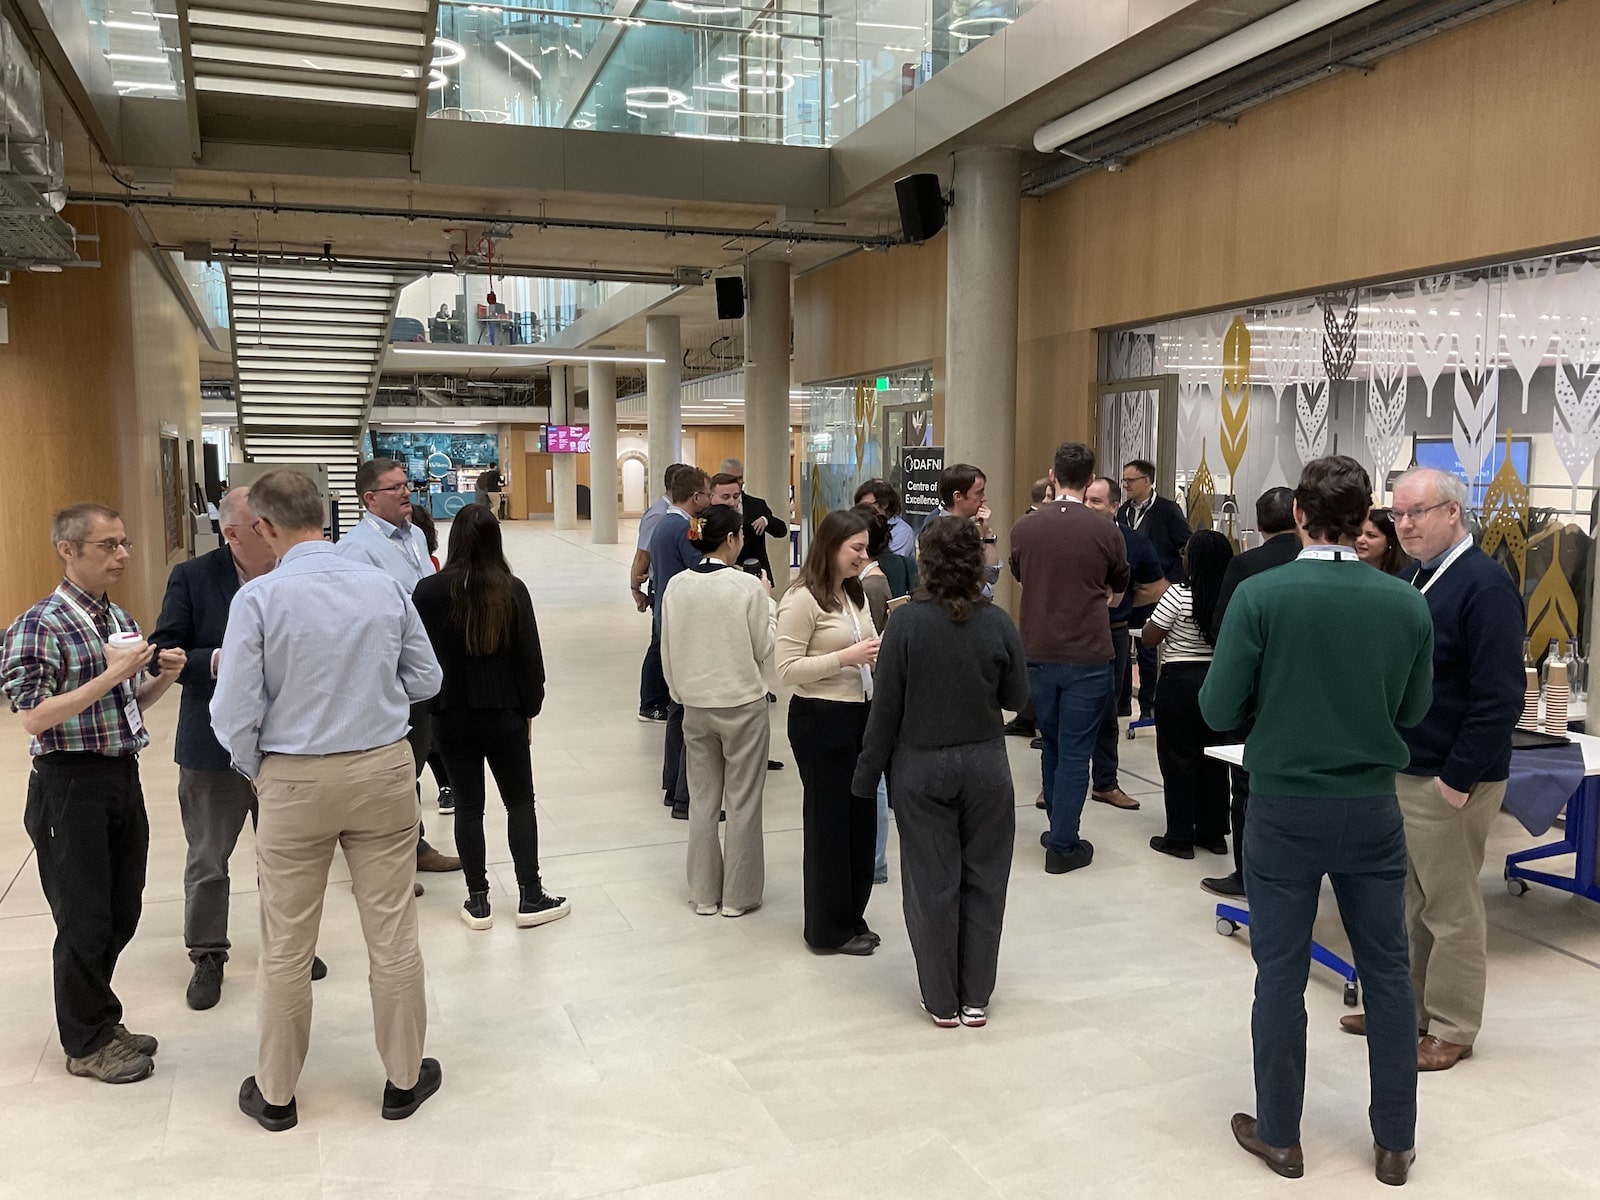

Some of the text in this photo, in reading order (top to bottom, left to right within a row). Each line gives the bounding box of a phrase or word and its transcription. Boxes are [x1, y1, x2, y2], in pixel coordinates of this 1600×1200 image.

[913, 459, 942, 470] DAFNI
[907, 480, 938, 492] Centre of
[905, 494, 939, 506] Excellence
